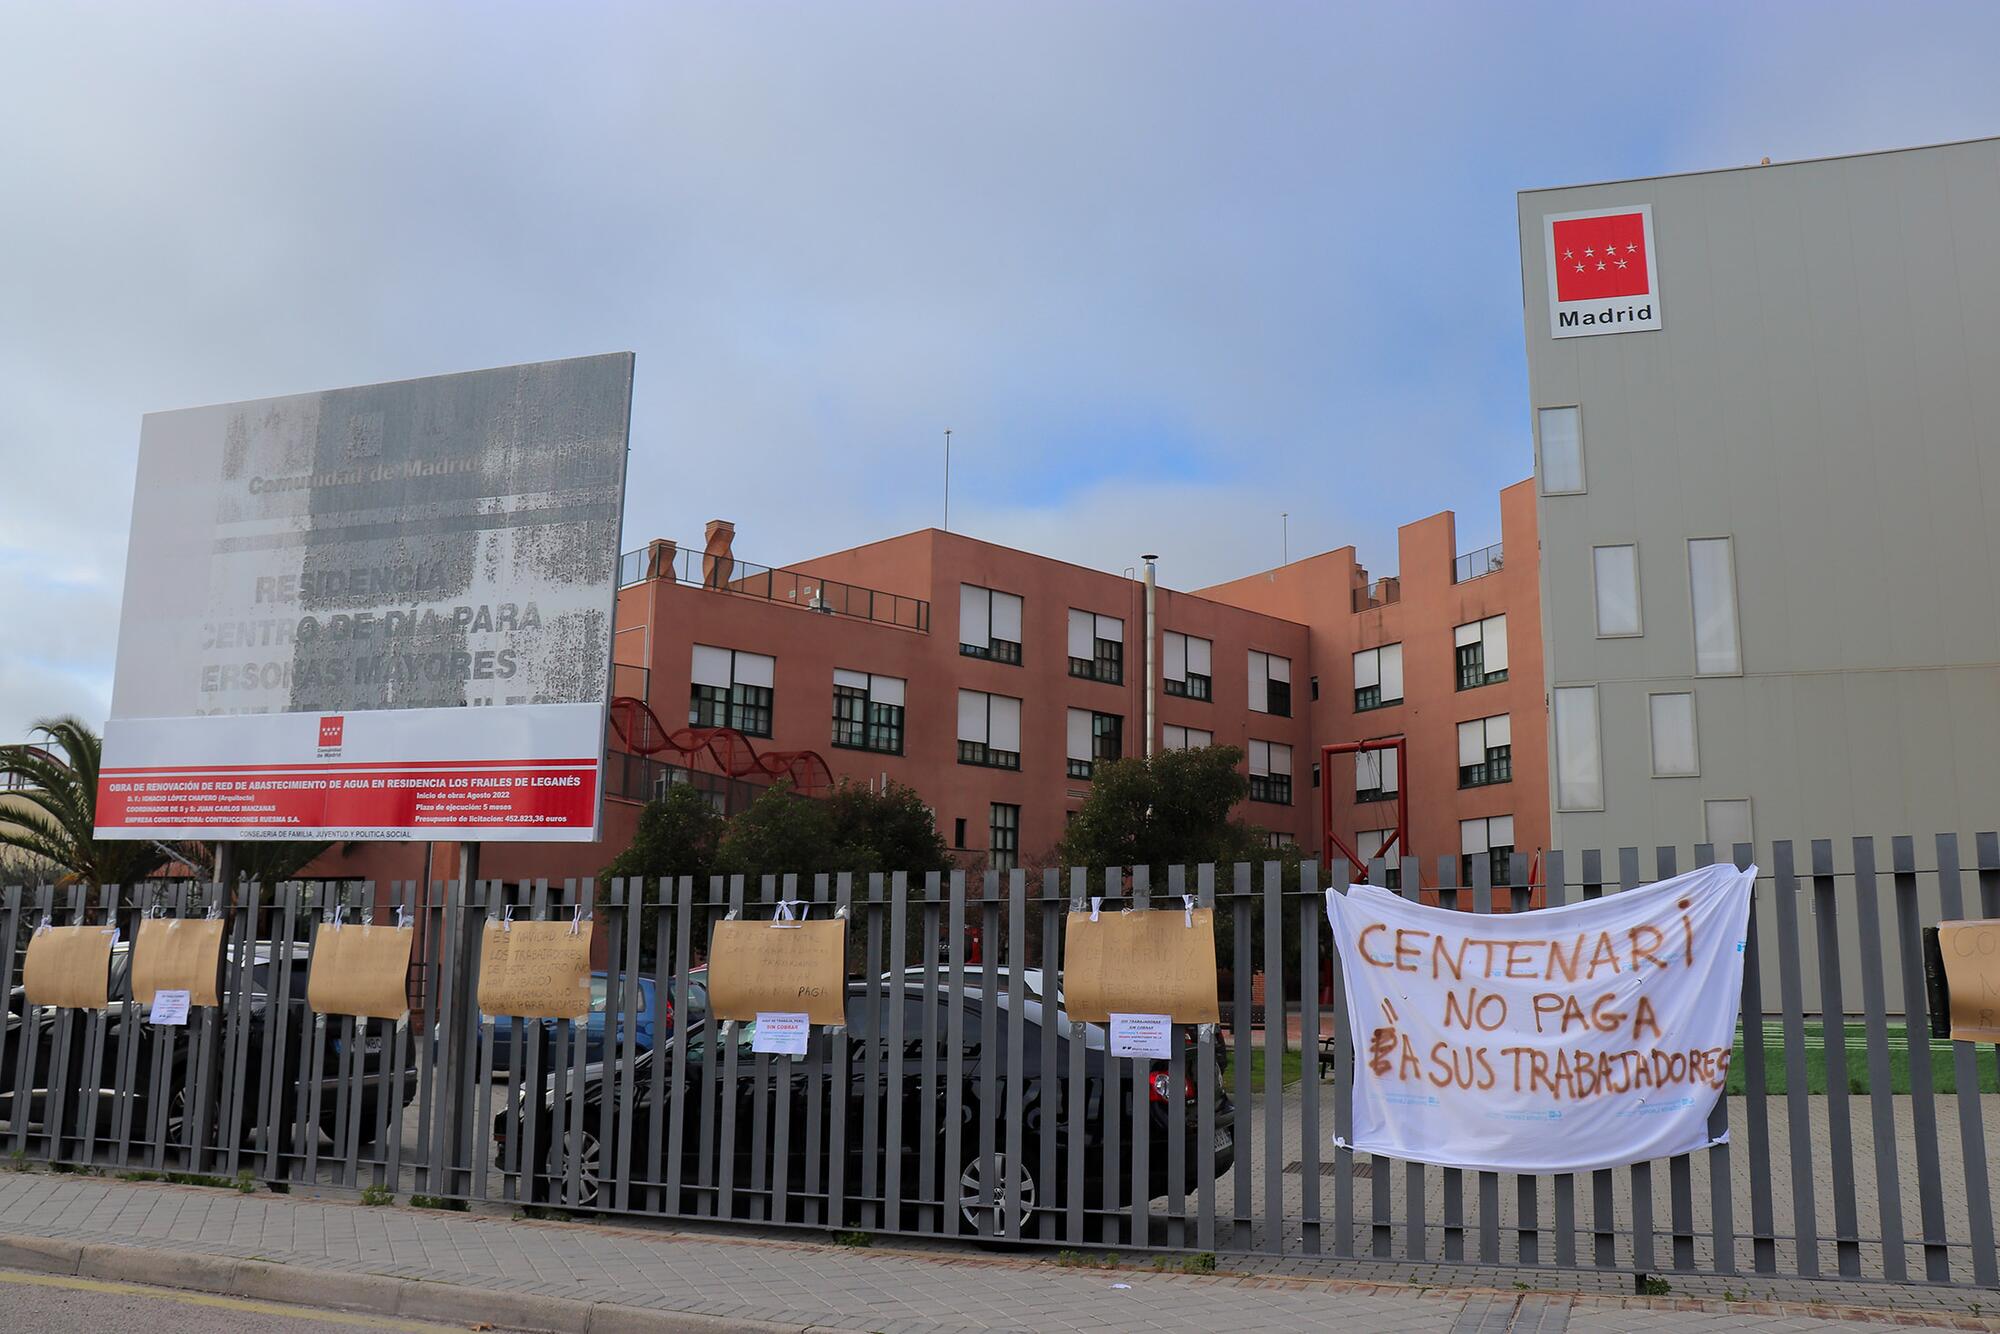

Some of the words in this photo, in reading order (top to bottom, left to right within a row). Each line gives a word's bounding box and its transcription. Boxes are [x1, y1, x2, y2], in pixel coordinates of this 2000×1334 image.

[1559, 305, 1652, 327] Madrid
[249, 466, 363, 495] Comunidad
[370, 464, 394, 482] de
[404, 455, 481, 480] Madrid
[255, 566, 449, 604] RESIDENCIA
[202, 616, 320, 650] CENTRO
[331, 612, 374, 641] DE
[384, 602, 441, 638] DÍA
[452, 602, 543, 635] PARA
[200, 657, 345, 692] ERSONAS
[355, 649, 517, 685] MAYORES
[109, 783, 131, 792] OBRA
[134, 783, 145, 791] DE
[146, 781, 199, 791] RENOVACIÓN
[201, 782, 214, 790] DE
[215, 782, 233, 790] RED
[235, 781, 247, 790] DE
[249, 780, 327, 790] ABASTECIMIENTO
[329, 780, 341, 789] DE
[343, 780, 369, 789] AGUA
[372, 780, 385, 788] EN
[387, 778, 446, 788] RESIDENCIA
[449, 778, 468, 787] LOS
[471, 778, 512, 787] FRAILES
[515, 777, 528, 786] DE
[531, 775, 581, 786] LEGANÉS
[467, 792, 491, 800] Agosto
[1444, 988, 1507, 1031] NO
[1533, 992, 1662, 1040] PAGA
[1428, 1042, 1496, 1090] SUS
[1501, 1046, 1731, 1099] TRABAJADORES
